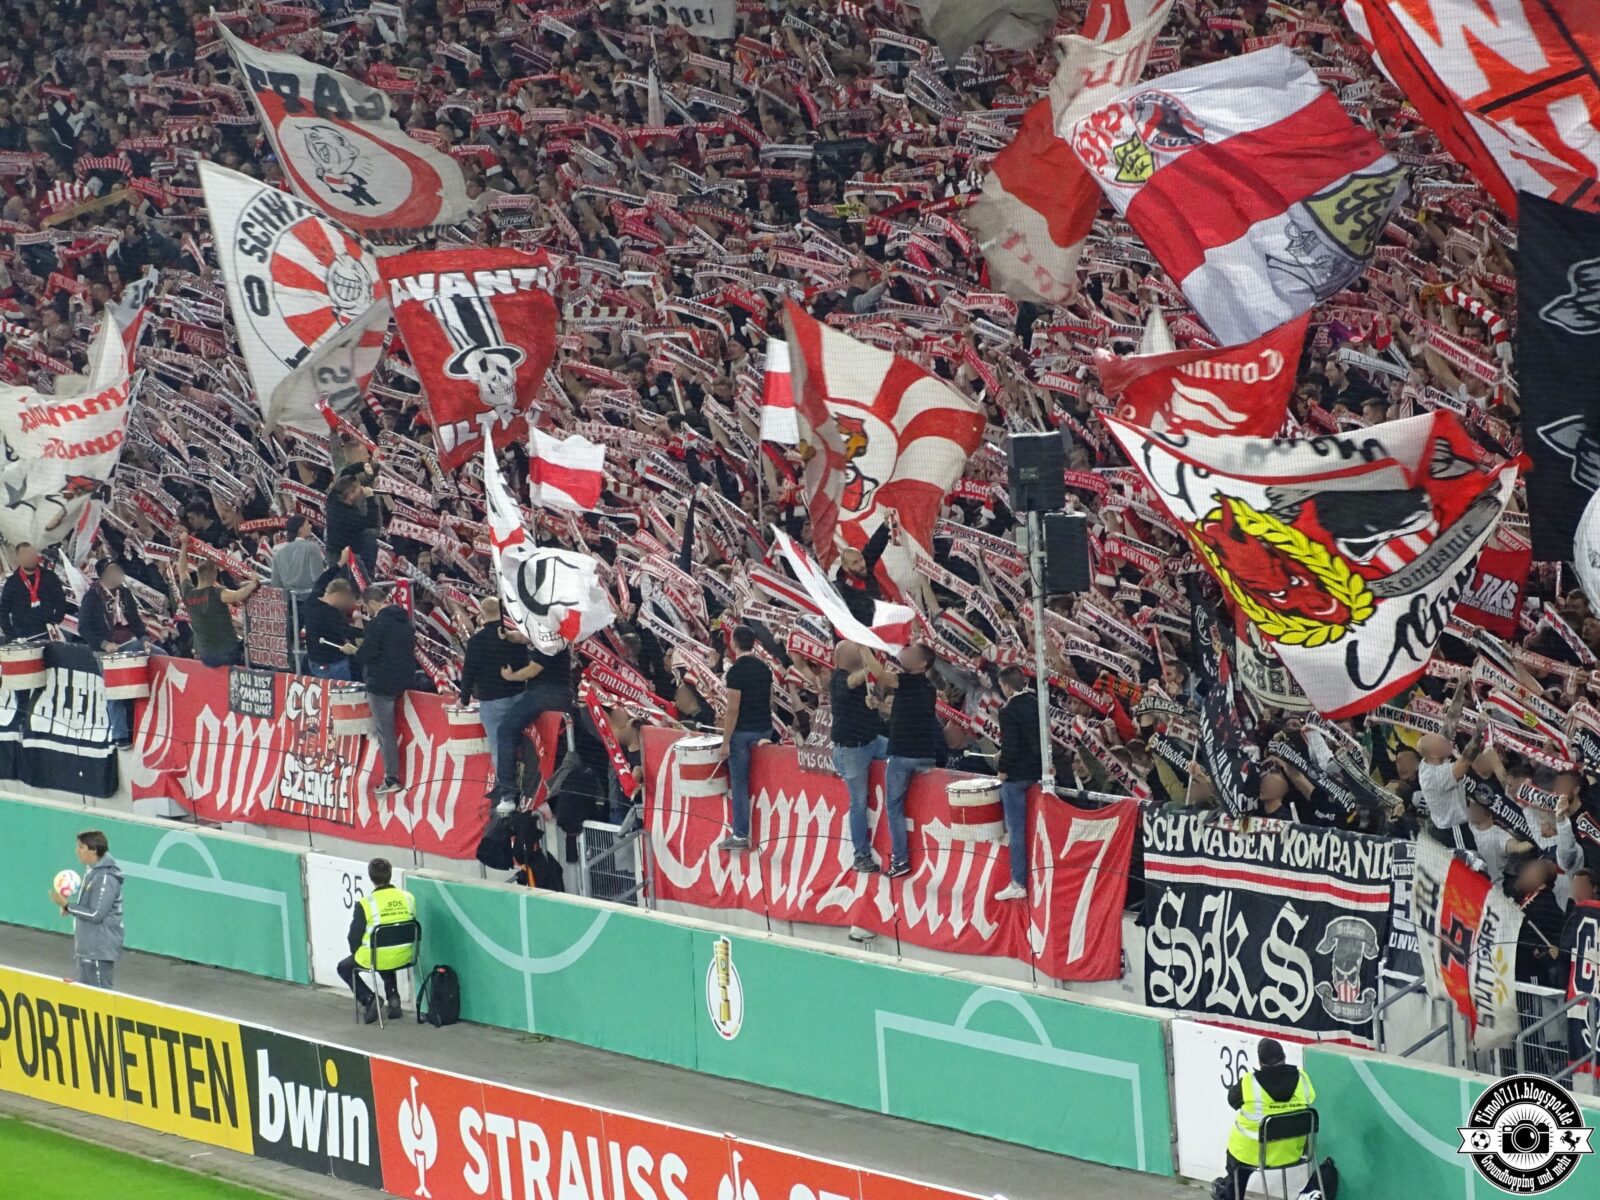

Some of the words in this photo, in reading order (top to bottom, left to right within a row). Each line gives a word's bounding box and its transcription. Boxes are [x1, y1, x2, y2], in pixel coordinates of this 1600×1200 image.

[1373, 523, 1478, 596] Kompanie
[1462, 566, 1519, 612] LTRAS
[256, 1049, 371, 1167] bwin
[458, 1106, 689, 1200] STRAUSS
